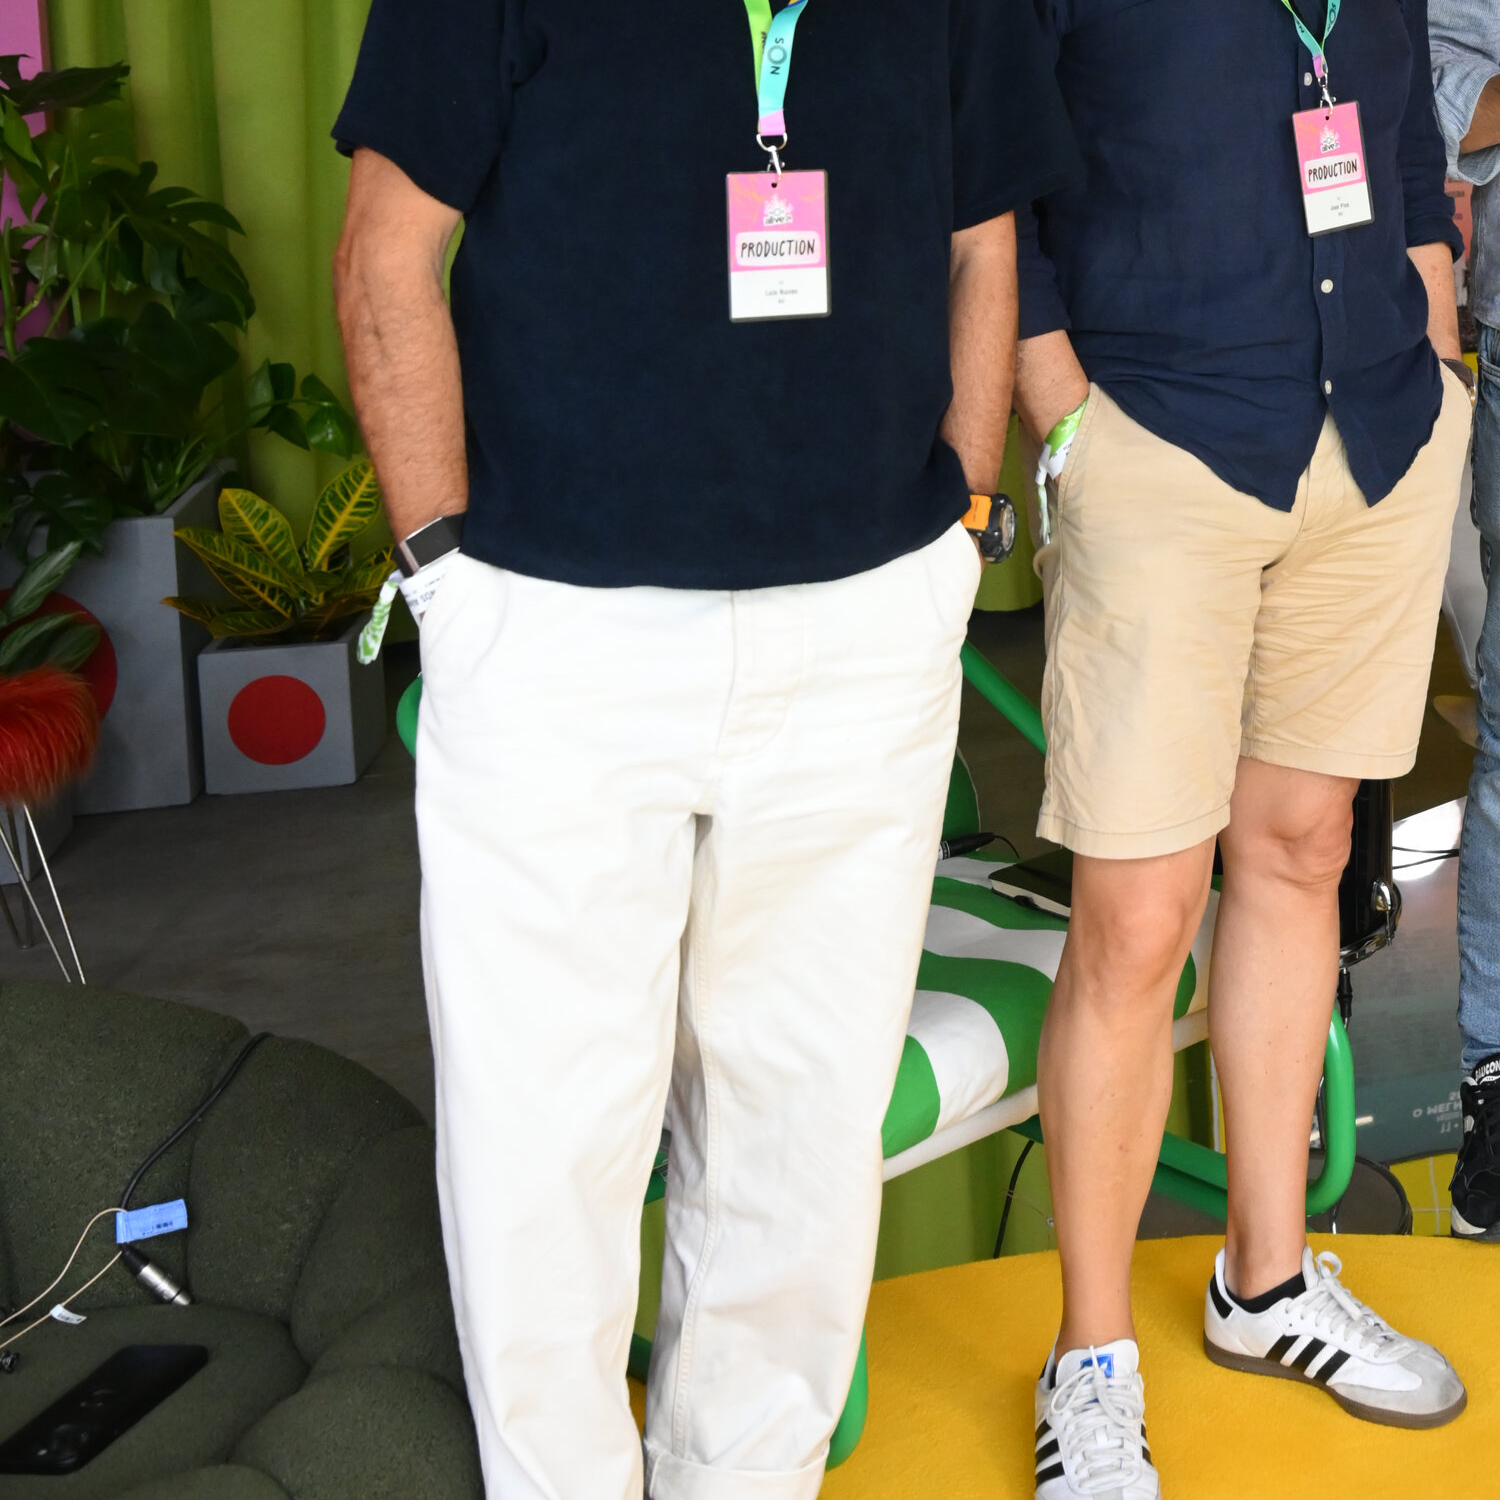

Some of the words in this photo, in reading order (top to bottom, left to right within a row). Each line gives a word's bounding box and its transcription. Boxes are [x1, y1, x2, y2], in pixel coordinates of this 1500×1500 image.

[767, 37, 788, 76] NOS
[1308, 158, 1358, 183] PRODUCTION
[741, 239, 816, 259] PRODUCTION
